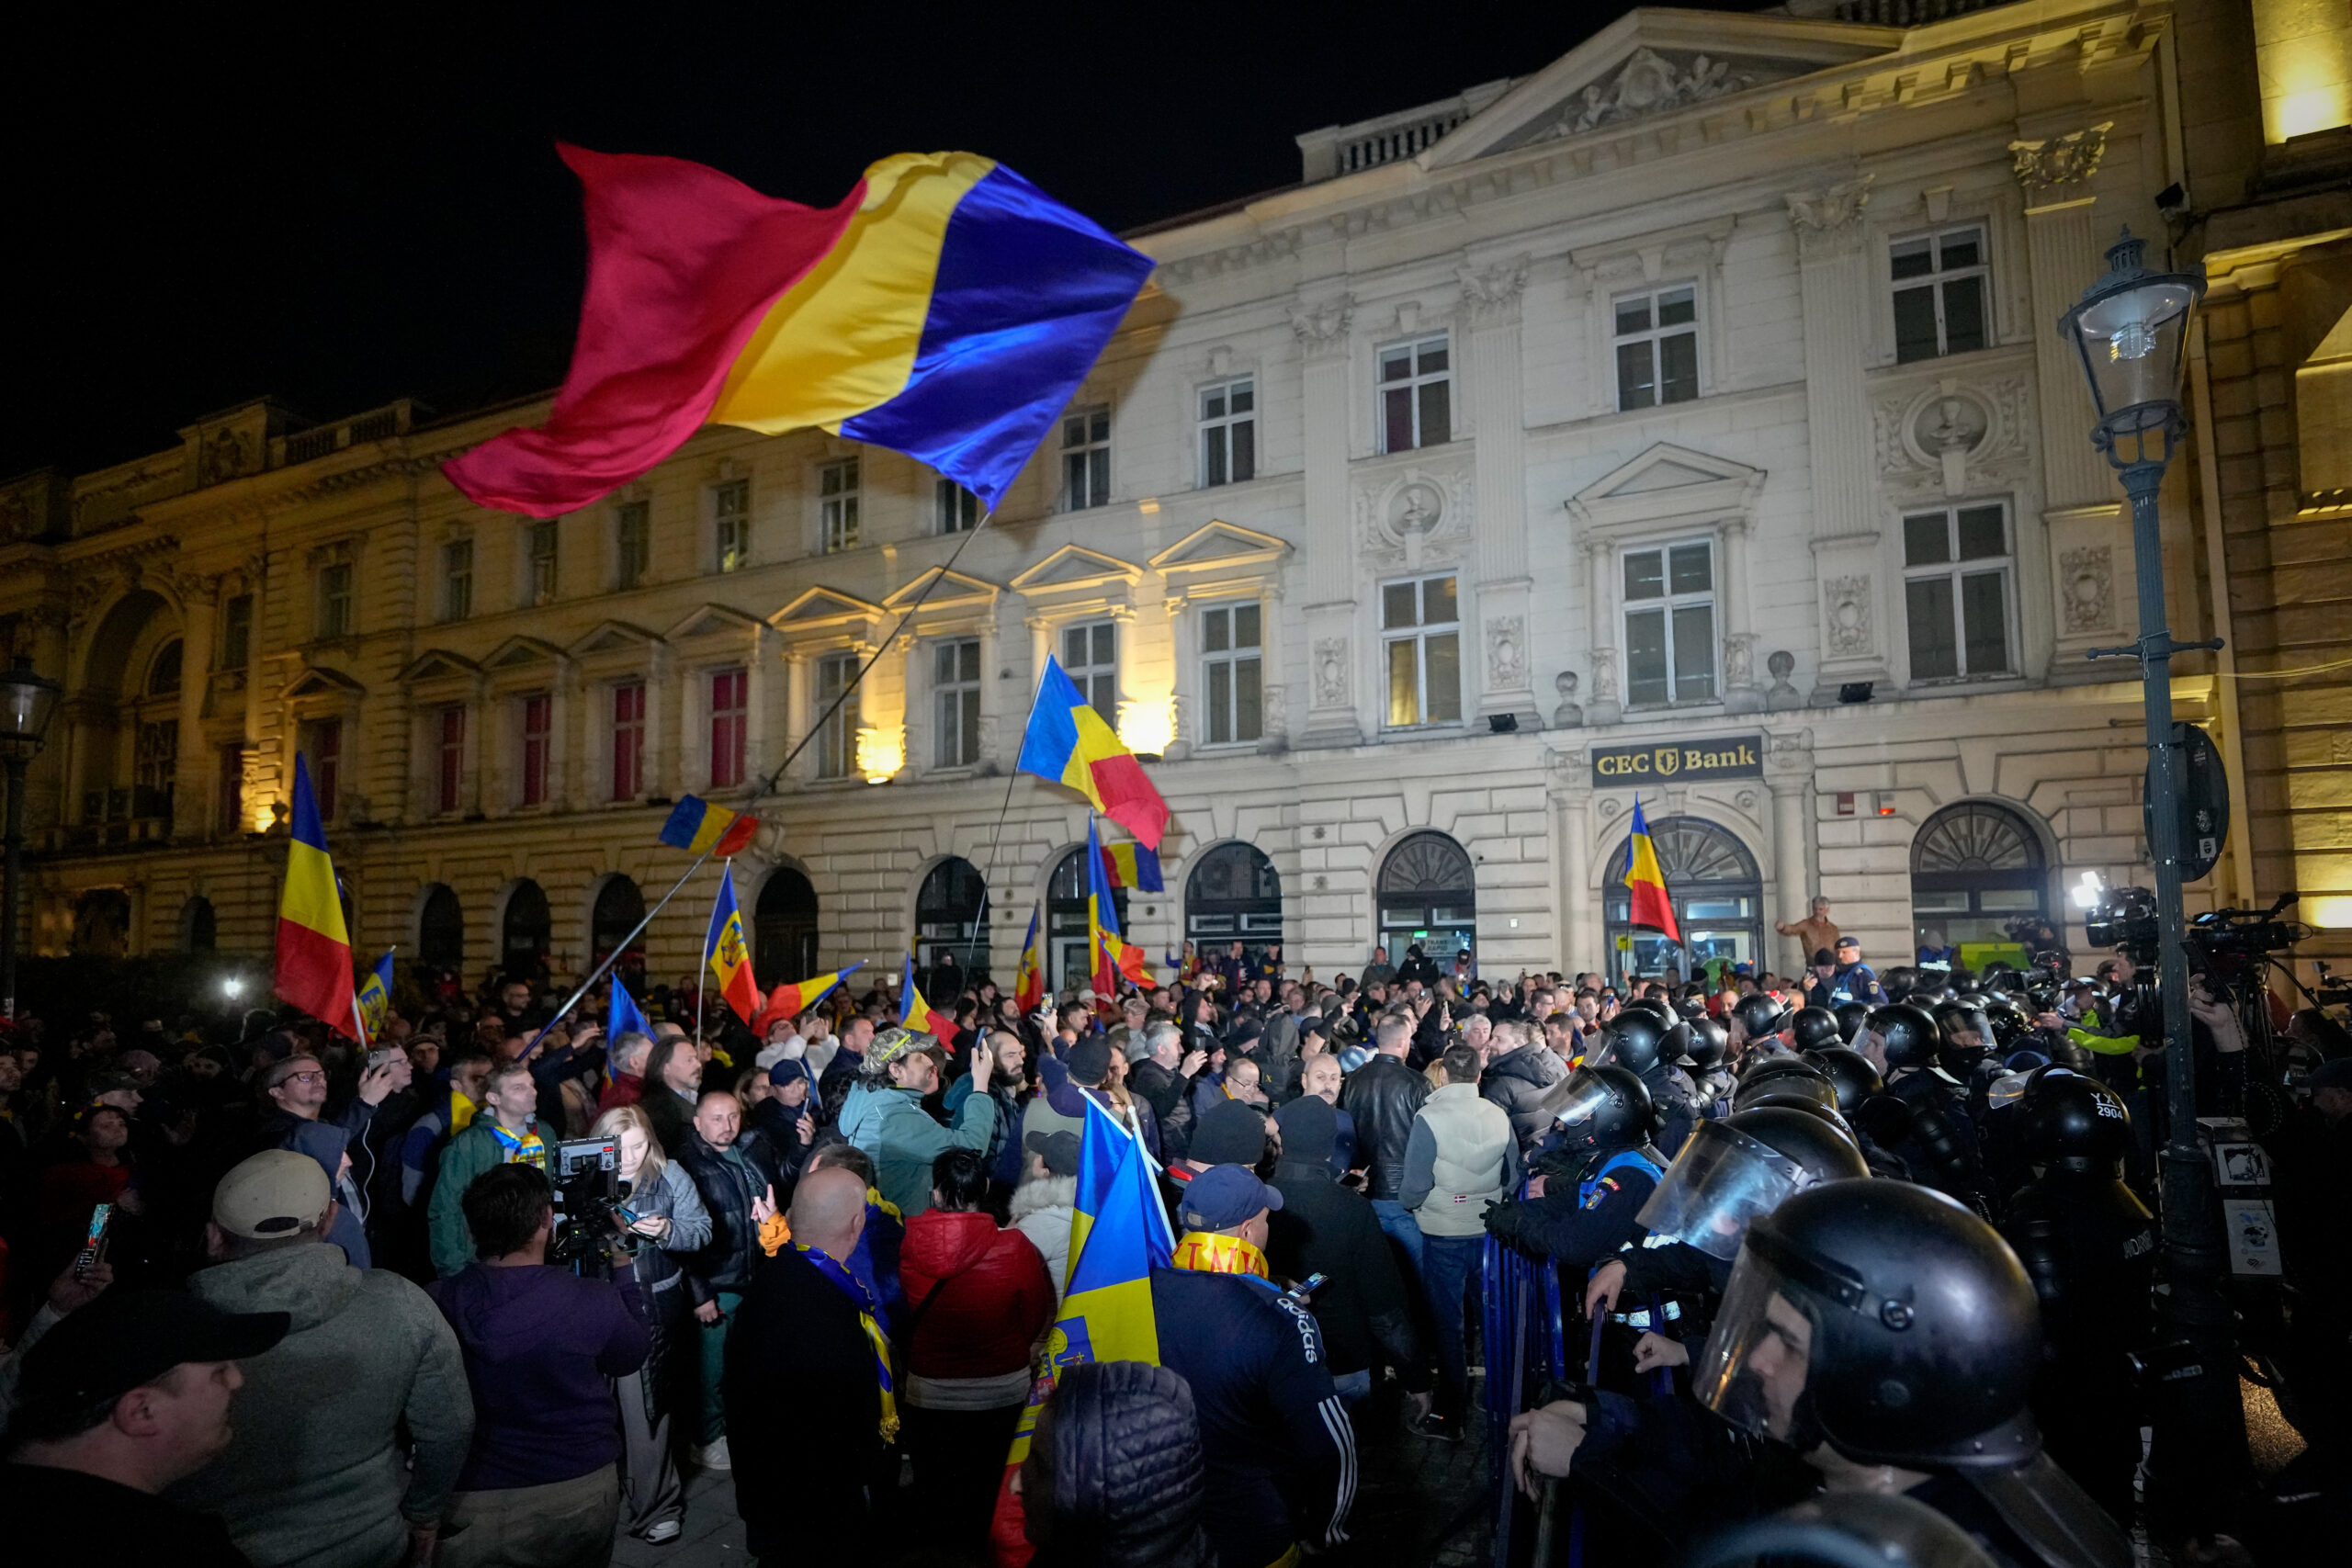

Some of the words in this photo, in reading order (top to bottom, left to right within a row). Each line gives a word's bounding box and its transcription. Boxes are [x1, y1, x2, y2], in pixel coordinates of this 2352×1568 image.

[1597, 753, 1650, 775] CEC
[1684, 744, 1757, 771] Bank
[2097, 1106, 2123, 1120] 2904
[1277, 1297, 1317, 1363] adidas
